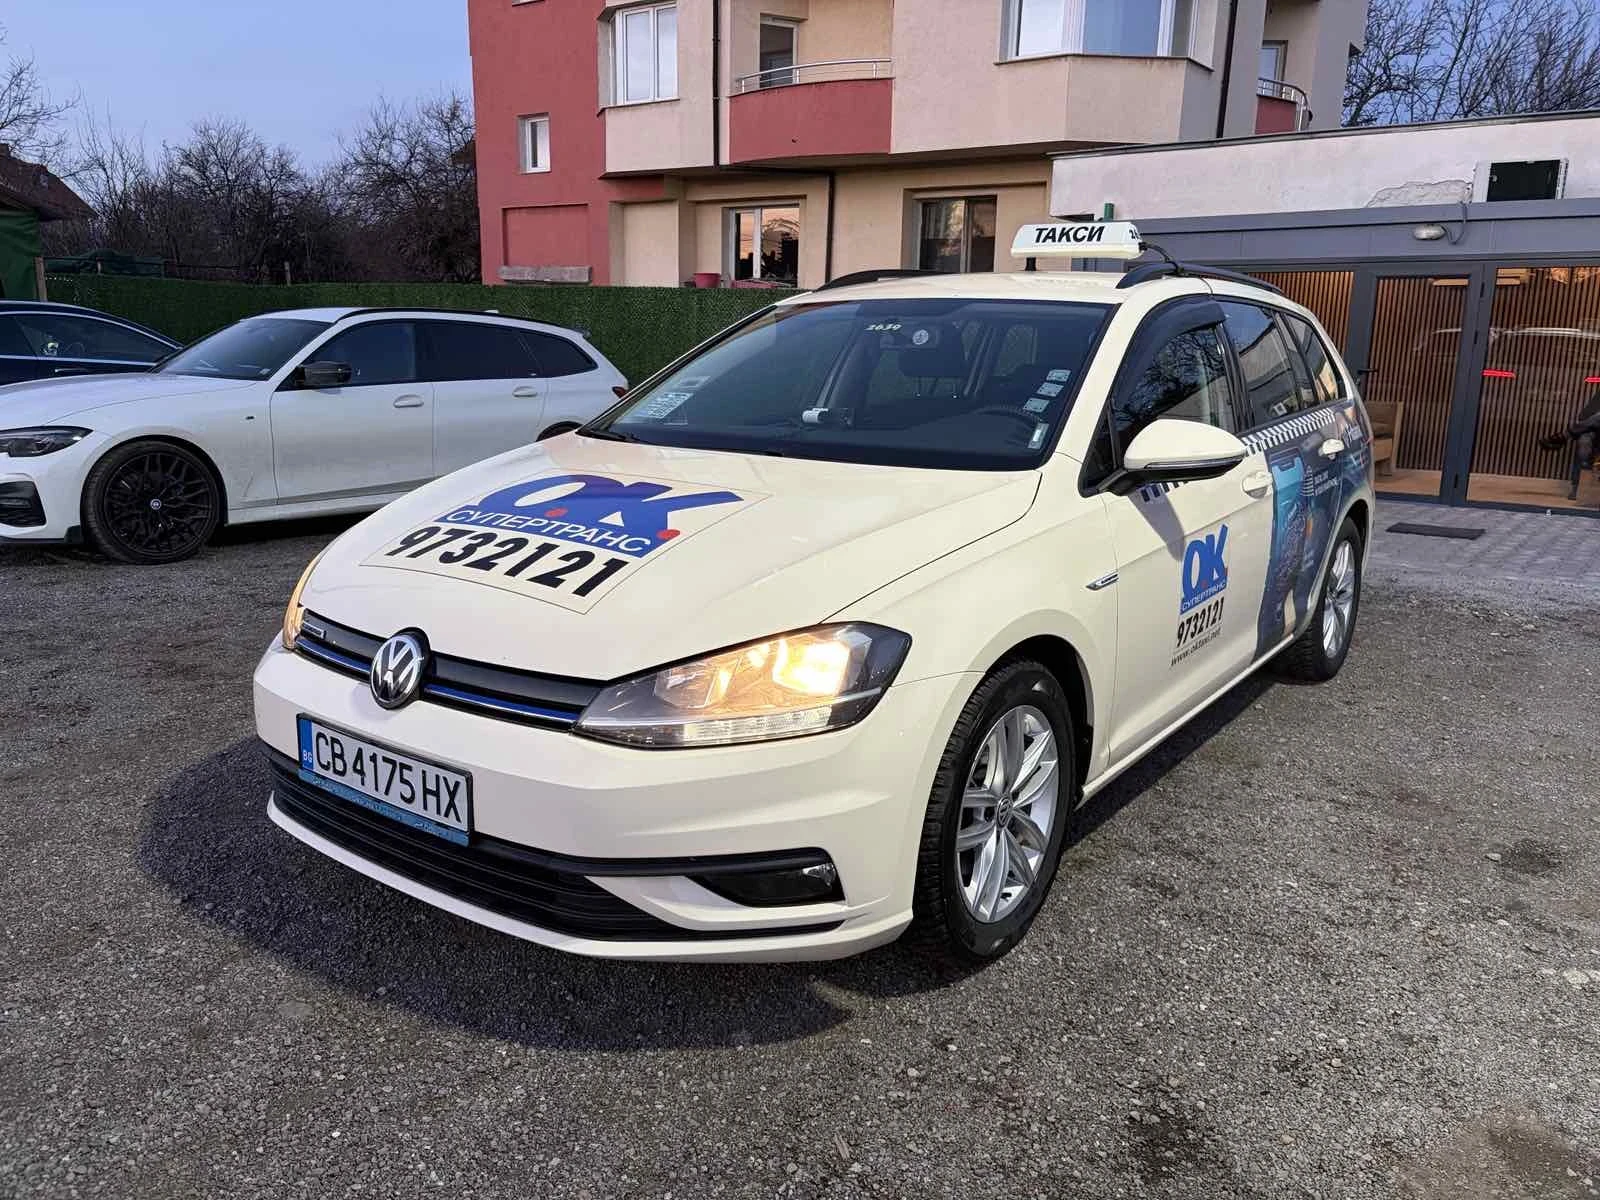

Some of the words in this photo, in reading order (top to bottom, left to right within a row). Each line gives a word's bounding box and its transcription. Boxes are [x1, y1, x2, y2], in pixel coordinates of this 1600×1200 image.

[1035, 226, 1105, 244] ТАКСИ
[446, 508, 652, 553] СУПЕРТРАНС
[385, 526, 629, 598] 9732121
[1176, 596, 1225, 649] 9732121
[302, 750, 313, 764] BG
[352, 746, 416, 805] 4175
